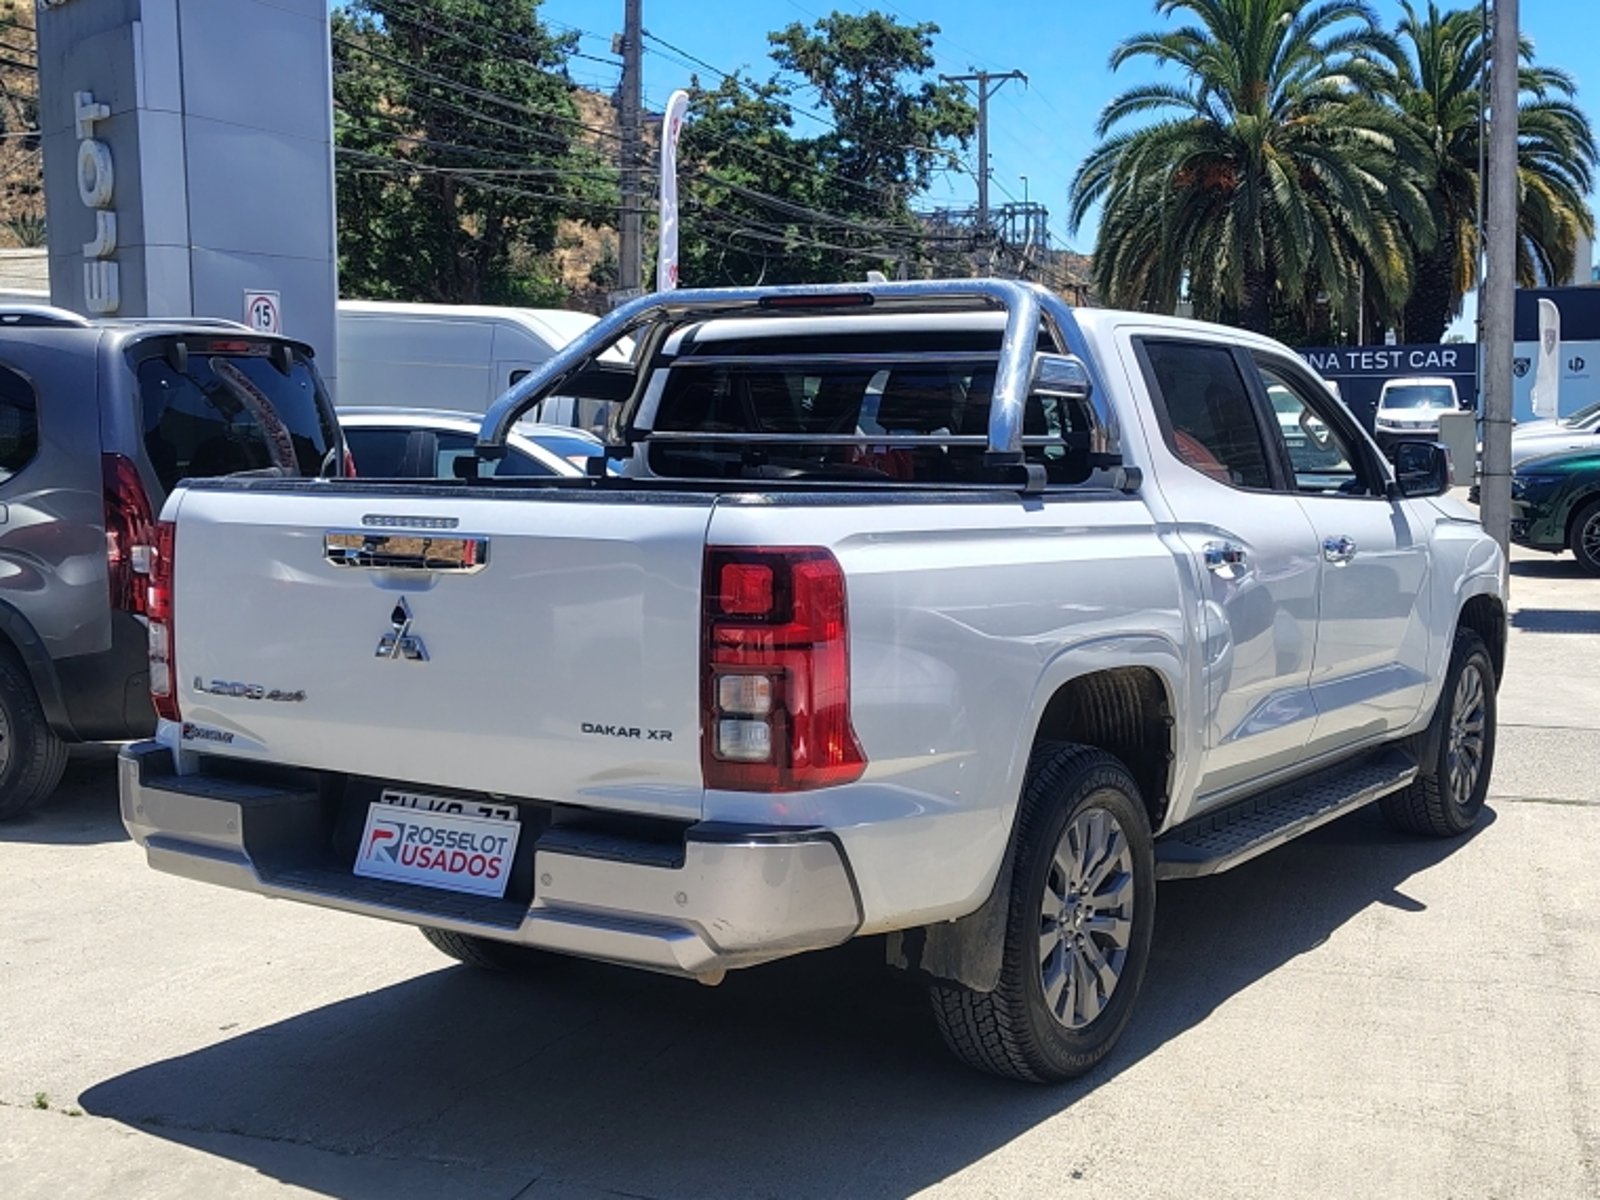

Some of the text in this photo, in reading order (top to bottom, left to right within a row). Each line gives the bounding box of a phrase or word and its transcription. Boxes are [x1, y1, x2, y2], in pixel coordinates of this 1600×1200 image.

[255, 304, 271, 327] 15
[1345, 351, 1404, 369] TEST
[1409, 350, 1457, 368] CAR
[581, 722, 673, 741] DAKAR XR
[406, 825, 508, 855] ROSSELOT
[401, 844, 502, 879] USADOS
